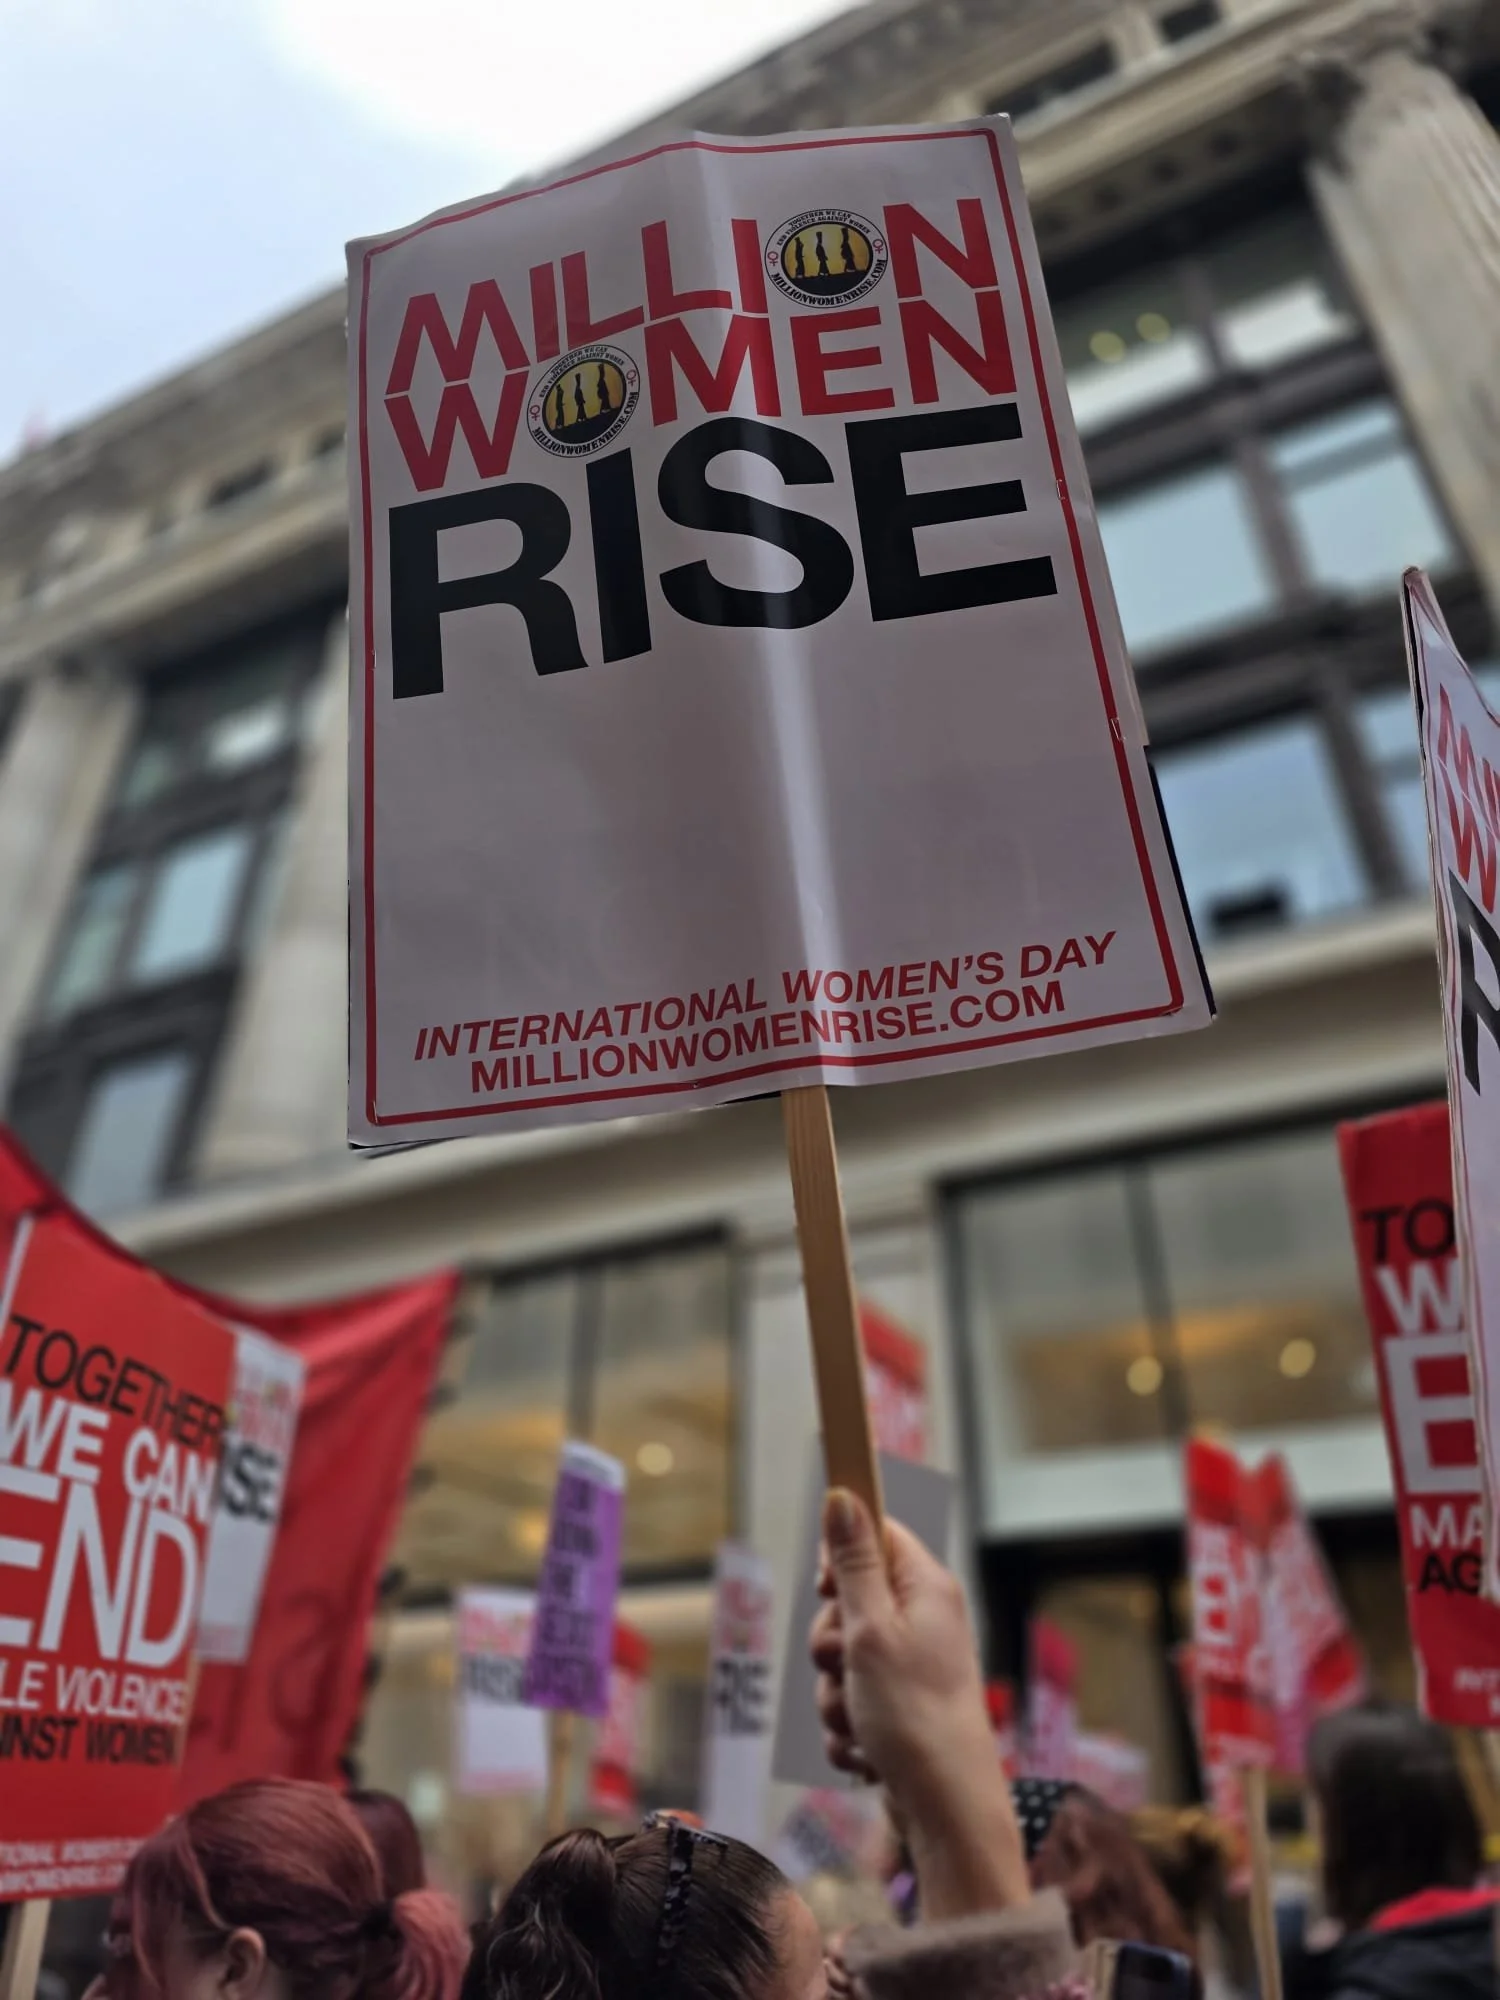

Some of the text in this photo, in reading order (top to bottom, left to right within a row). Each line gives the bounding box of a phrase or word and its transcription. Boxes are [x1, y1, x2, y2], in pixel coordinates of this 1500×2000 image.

[771, 259, 886, 305] MILLIONWOMENRISE.COM
[532, 391, 639, 455] MILLIONWOMENRISE.COM
[388, 402, 1058, 700] RISE
[413, 931, 1117, 1061] INTERNATIONAL WOMEN'S DAY
[470, 980, 1067, 1094] MILLIONWOMENRISE.COM
[1449, 868, 1500, 1097] R
[5, 1314, 225, 1452] TOGETHER
[0, 1375, 110, 1484] WE
[124, 1425, 215, 1527] CAN
[0, 1657, 190, 1725] LE VIOLENCE
